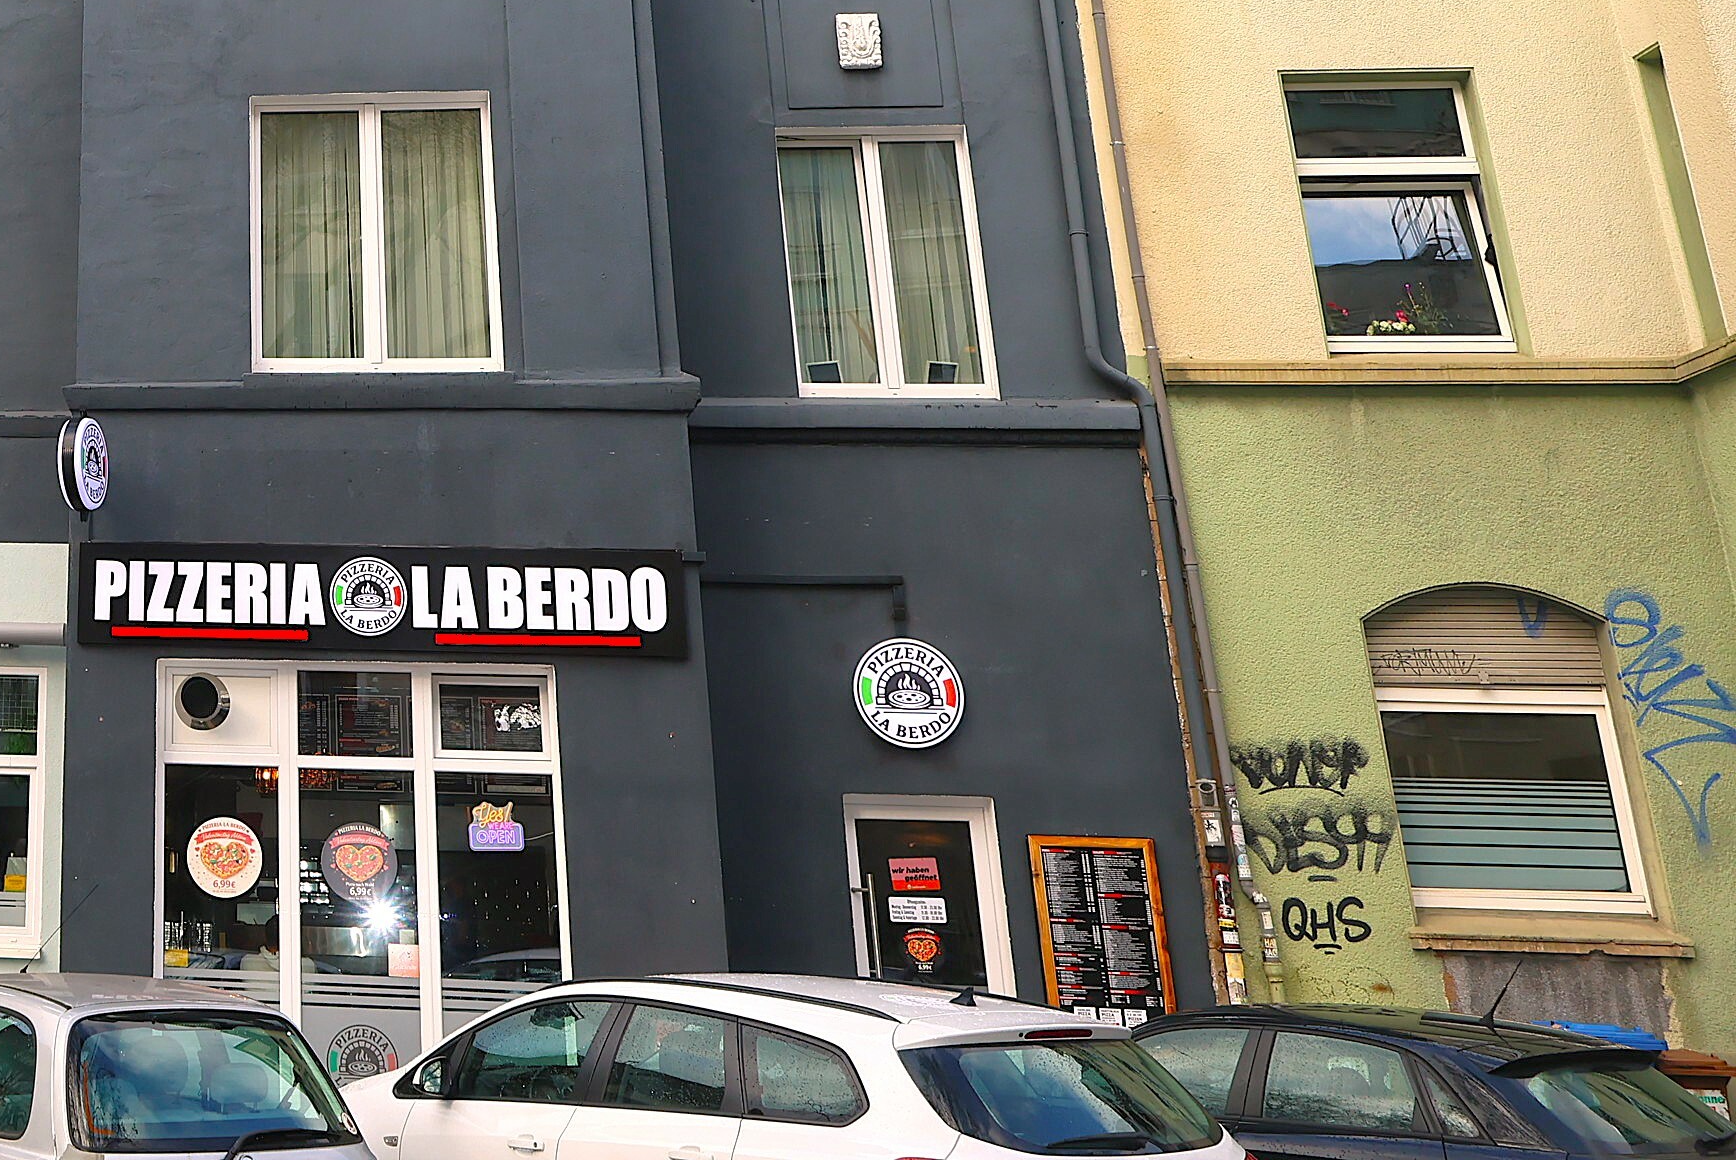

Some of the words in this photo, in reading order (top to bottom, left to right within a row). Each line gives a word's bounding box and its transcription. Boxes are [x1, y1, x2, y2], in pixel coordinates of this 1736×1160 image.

[341, 563, 395, 585] PIZZERIA
[93, 560, 326, 627] PIZZERIA
[410, 565, 479, 631] LA
[487, 567, 667, 633] BERDO
[341, 609, 353, 624] LA
[357, 610, 397, 629] BERDO
[867, 647, 945, 678] PIZZERIA
[871, 710, 890, 731] LA
[896, 712, 951, 739] BERDO
[473, 801, 514, 828] Yes!
[476, 830, 515, 844] OPEN
[904, 874, 937, 882] geöffnet
[906, 866, 929, 874] haben
[213, 879, 236, 889] 6,99€
[349, 887, 372, 896] 6,99€
[1282, 896, 1372, 943] QHS
[335, 1028, 389, 1052] PIZZERIA
